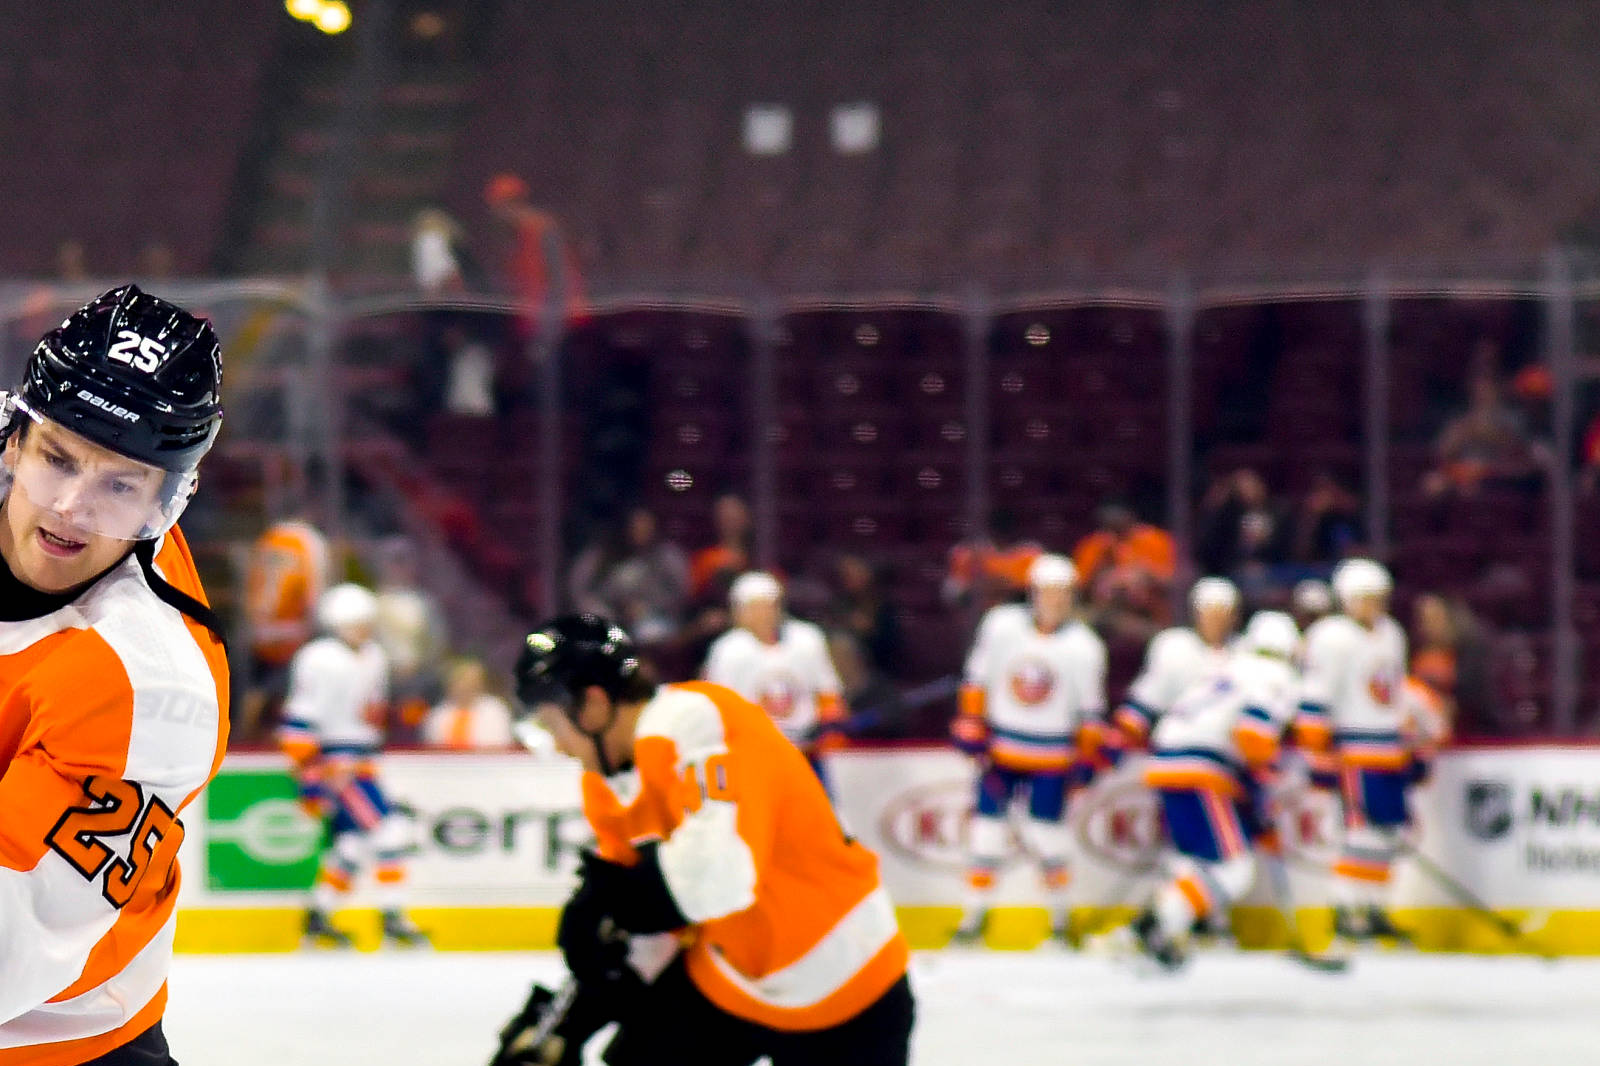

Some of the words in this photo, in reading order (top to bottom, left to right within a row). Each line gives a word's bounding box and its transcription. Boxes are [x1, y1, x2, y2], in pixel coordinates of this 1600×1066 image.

[108, 330, 166, 373] 25
[77, 389, 141, 423] BAUER
[44, 775, 185, 910] 25
